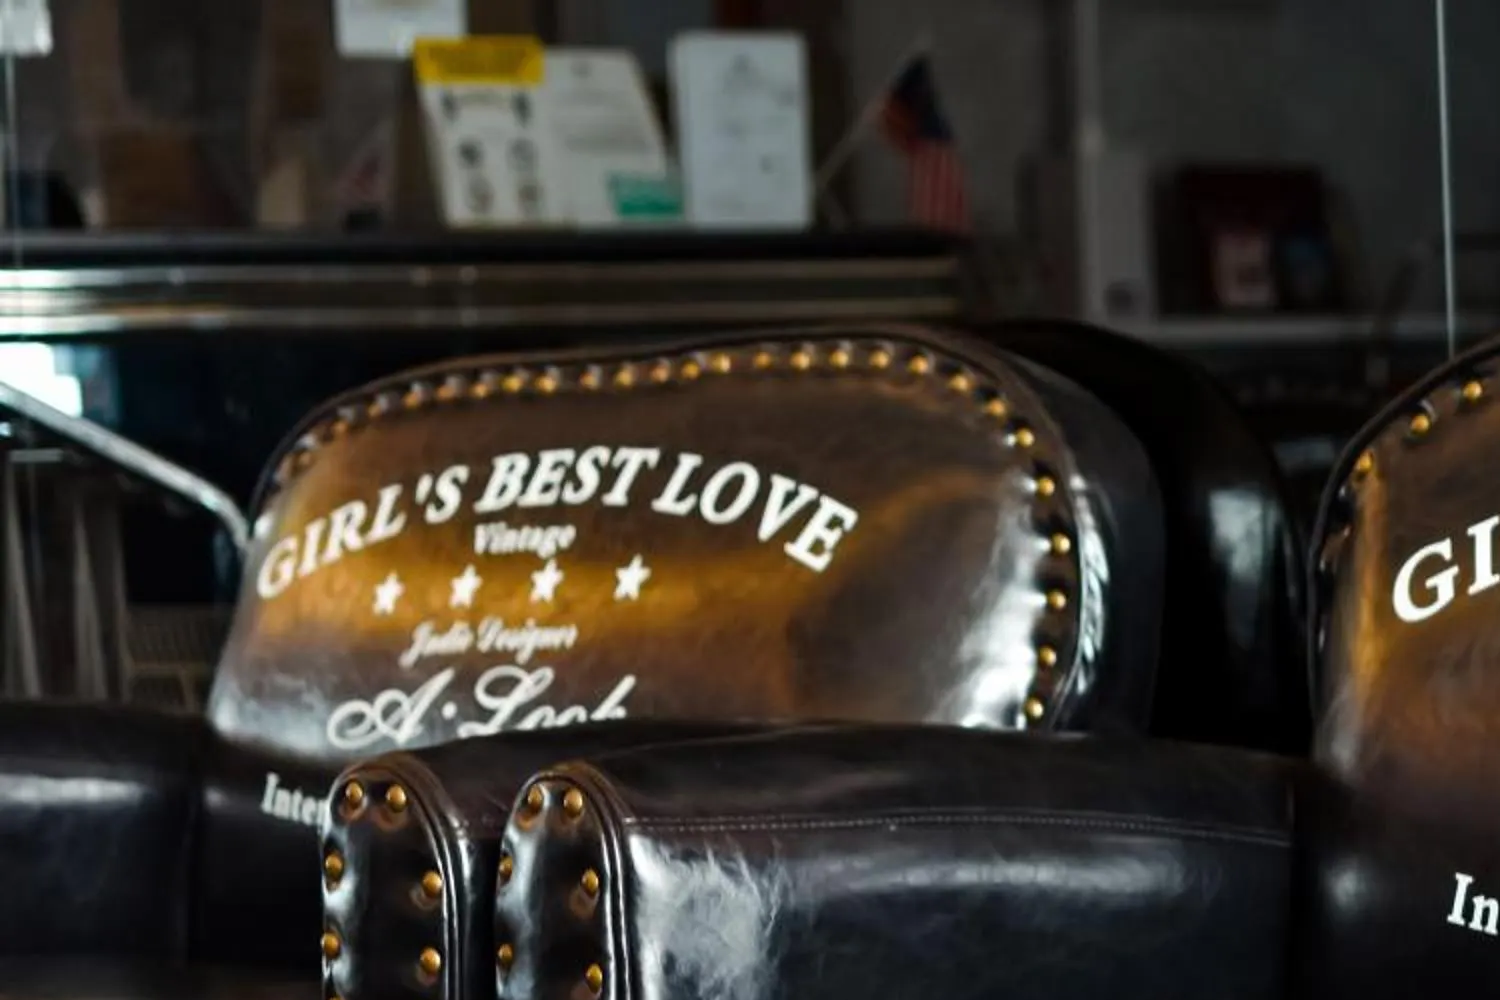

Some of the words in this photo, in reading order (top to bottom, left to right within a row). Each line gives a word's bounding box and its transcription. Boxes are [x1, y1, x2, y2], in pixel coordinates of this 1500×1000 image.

[255, 465, 469, 599] GIRL'S
[474, 445, 661, 513] BEST
[651, 453, 858, 572] LOVE
[474, 522, 577, 559] Vintage
